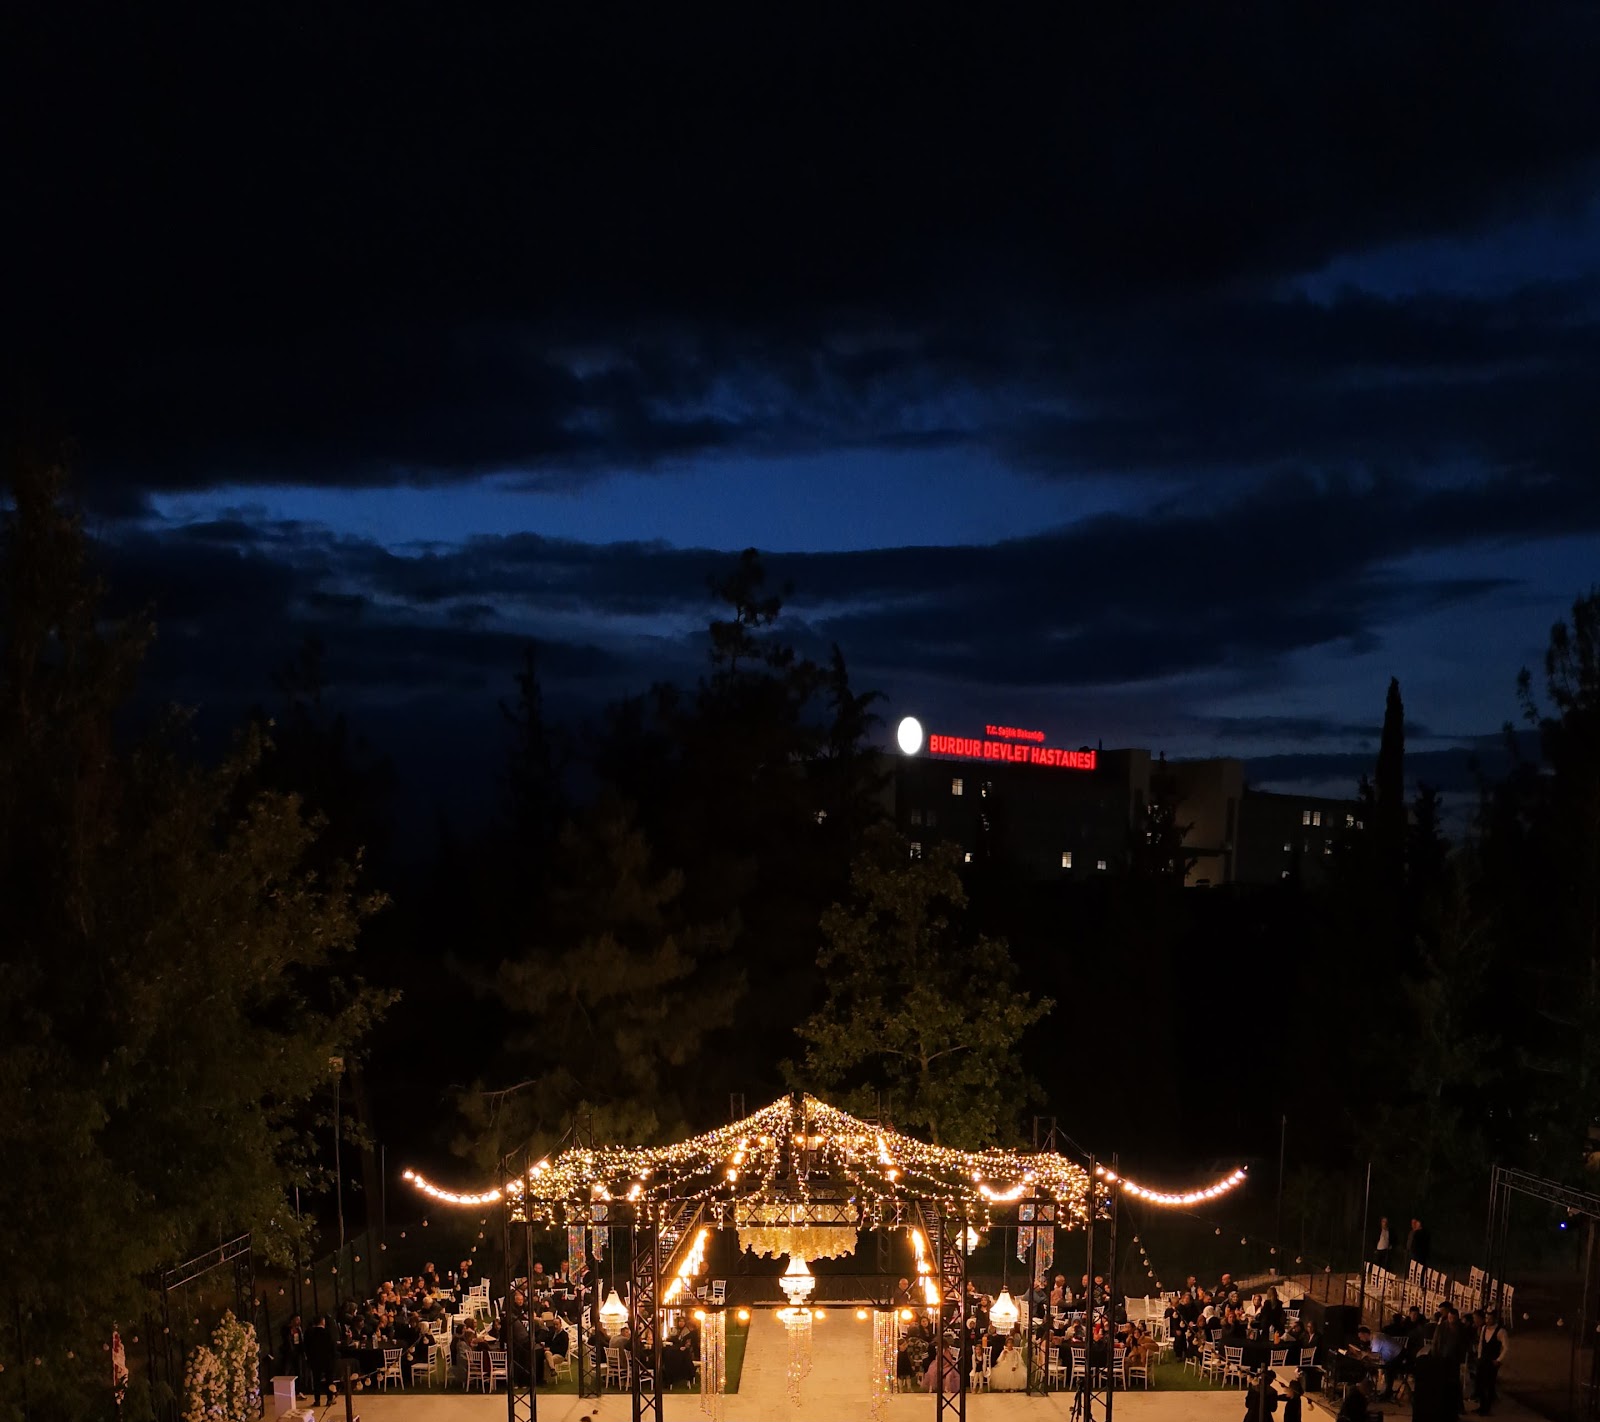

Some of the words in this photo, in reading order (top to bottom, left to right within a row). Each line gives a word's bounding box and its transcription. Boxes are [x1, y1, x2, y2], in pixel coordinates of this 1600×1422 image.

[930, 734, 982, 757] BURDUR
[983, 741, 1029, 762] DEVLET
[1031, 748, 1096, 770] HASTANESİ
